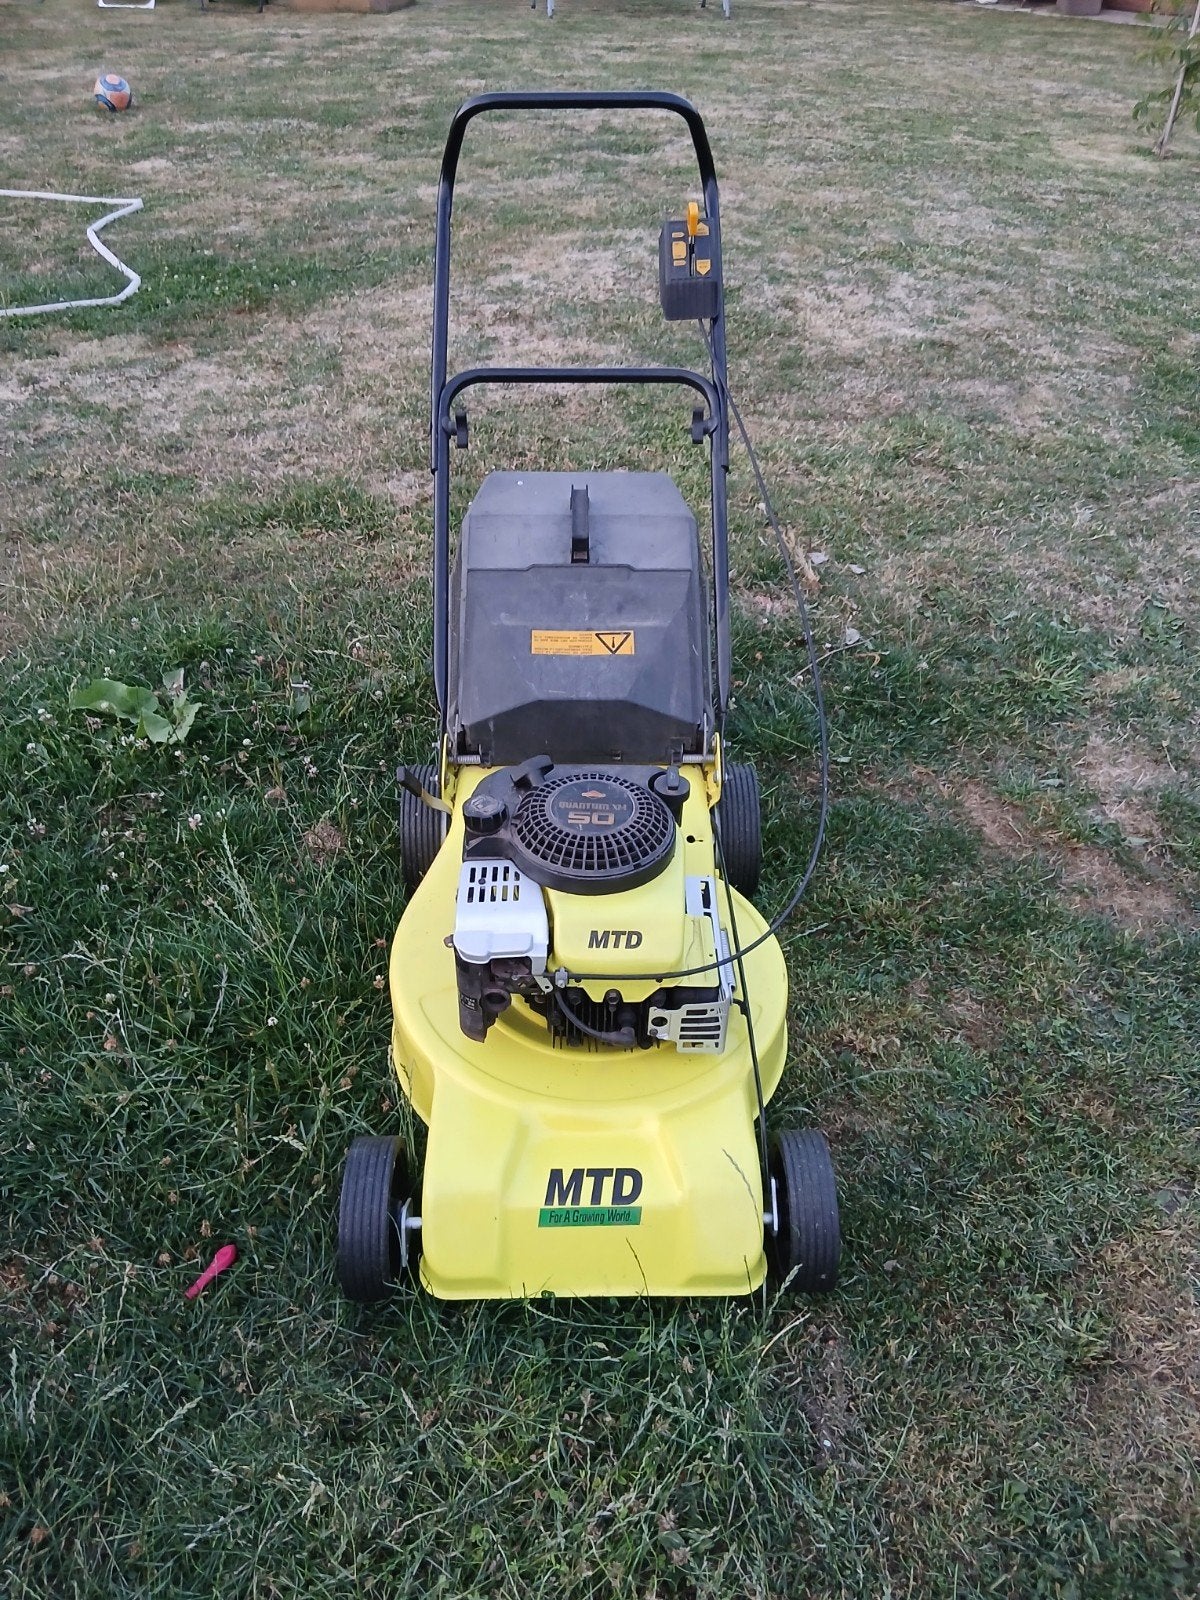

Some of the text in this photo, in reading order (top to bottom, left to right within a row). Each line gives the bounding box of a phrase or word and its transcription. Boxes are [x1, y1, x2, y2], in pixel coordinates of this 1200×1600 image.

[567, 811, 615, 825] 50
[588, 930, 643, 949] MTD
[544, 1168, 643, 1206] MTD
[549, 1210, 563, 1223] For
[563, 1210, 571, 1222] A
[572, 1209, 605, 1225] Growing
